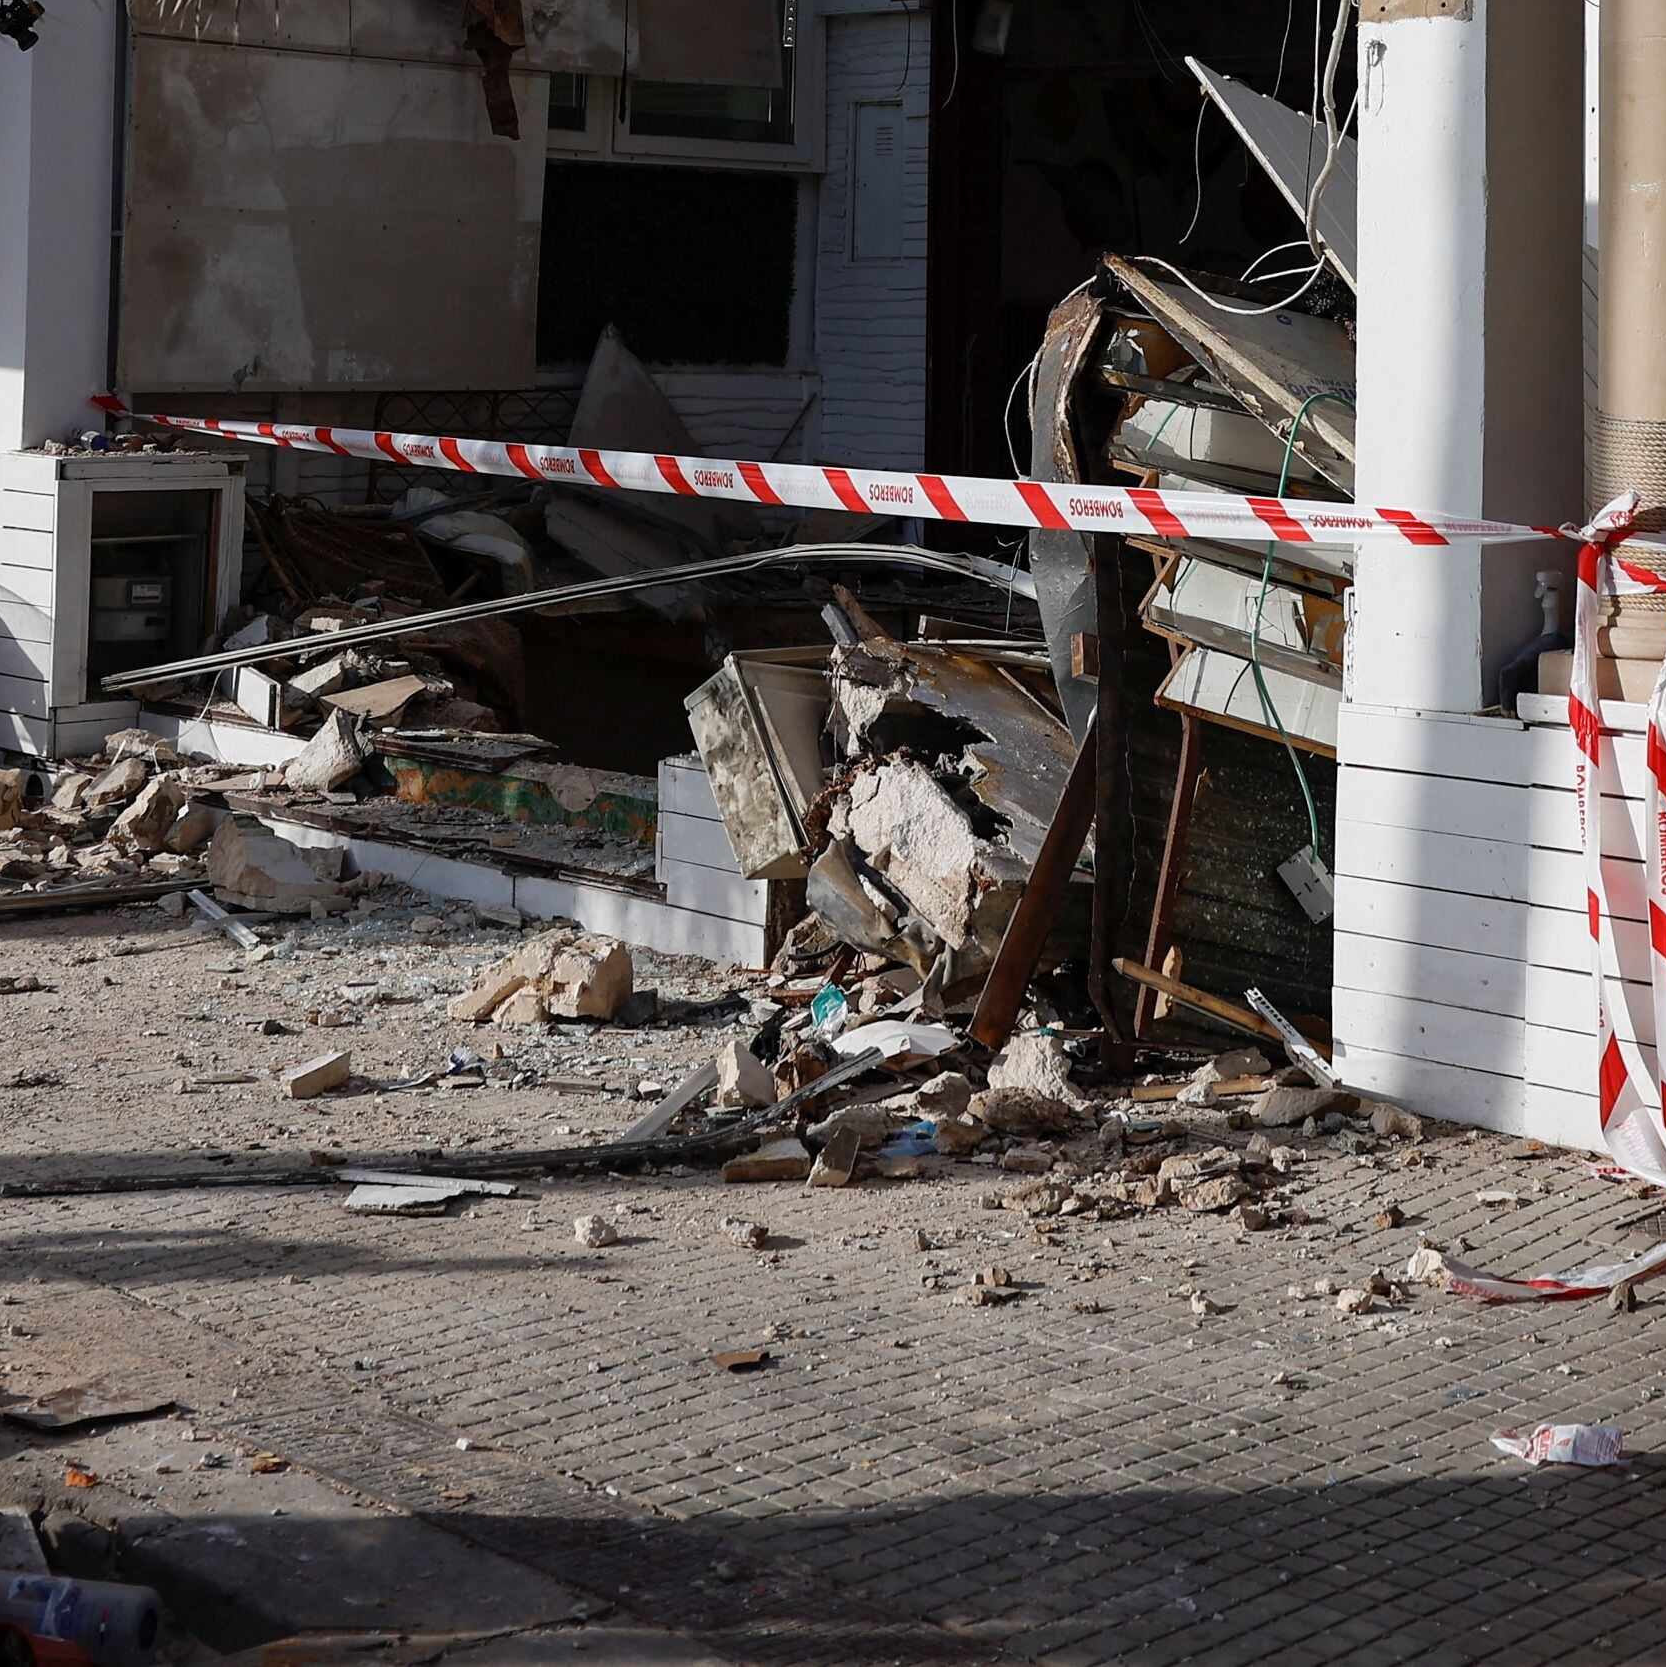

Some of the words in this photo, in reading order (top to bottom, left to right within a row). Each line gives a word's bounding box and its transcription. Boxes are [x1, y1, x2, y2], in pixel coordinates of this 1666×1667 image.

[539, 455, 576, 474] BOMBEROS
[693, 468, 734, 489] BOMBEROS
[869, 483, 914, 504] BOMBEROS
[1069, 497, 1124, 519] BOMBEROS
